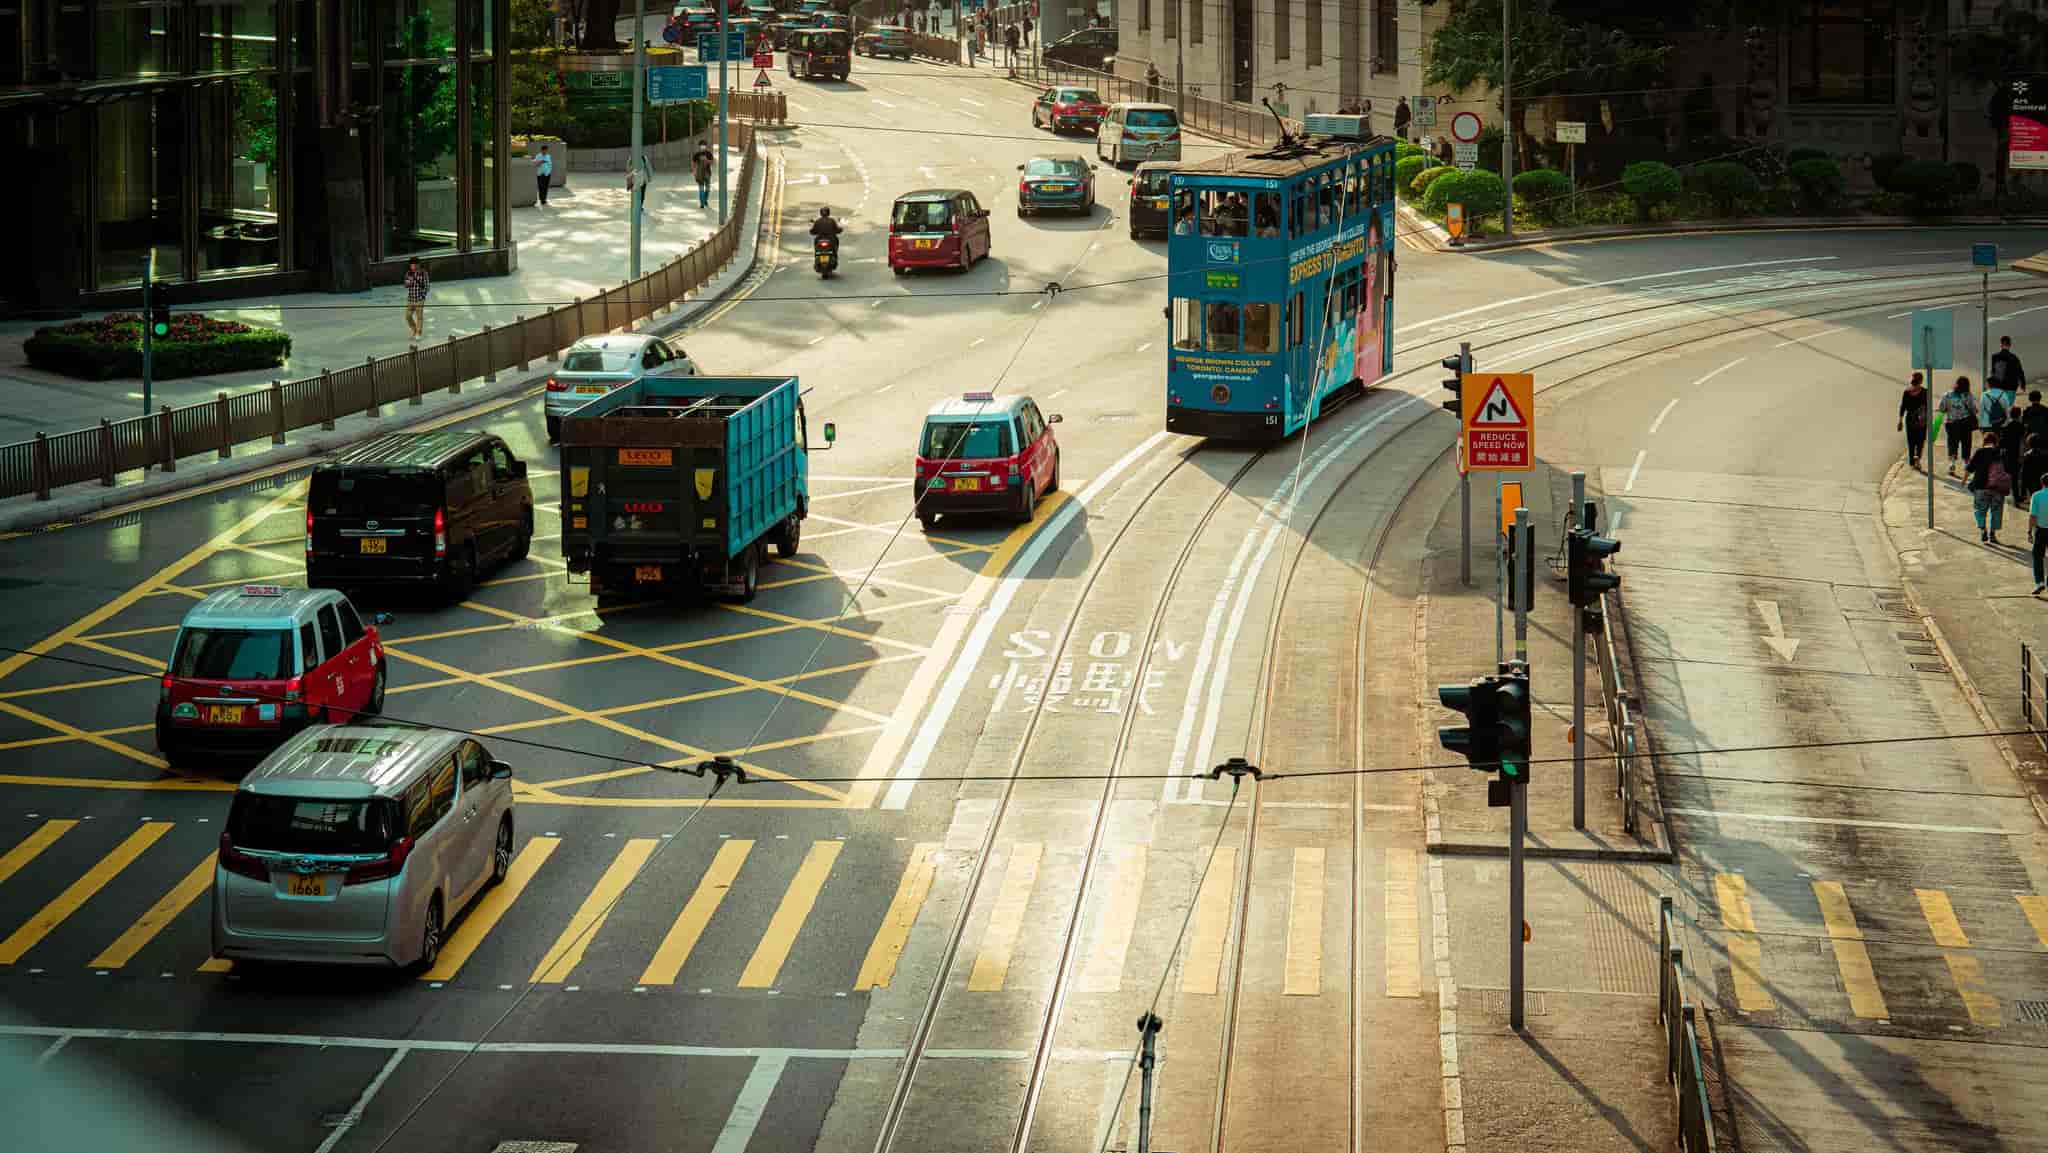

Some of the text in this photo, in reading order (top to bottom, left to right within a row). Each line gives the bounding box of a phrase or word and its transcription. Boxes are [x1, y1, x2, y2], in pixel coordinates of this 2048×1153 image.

[1290, 254, 1321, 285] EXPRESS
[1235, 359, 1272, 367] COLLEGE
[1265, 416, 1278, 425] 151
[1480, 433, 1518, 441] REDUCE
[1472, 441, 1526, 449] SPEED NOW
